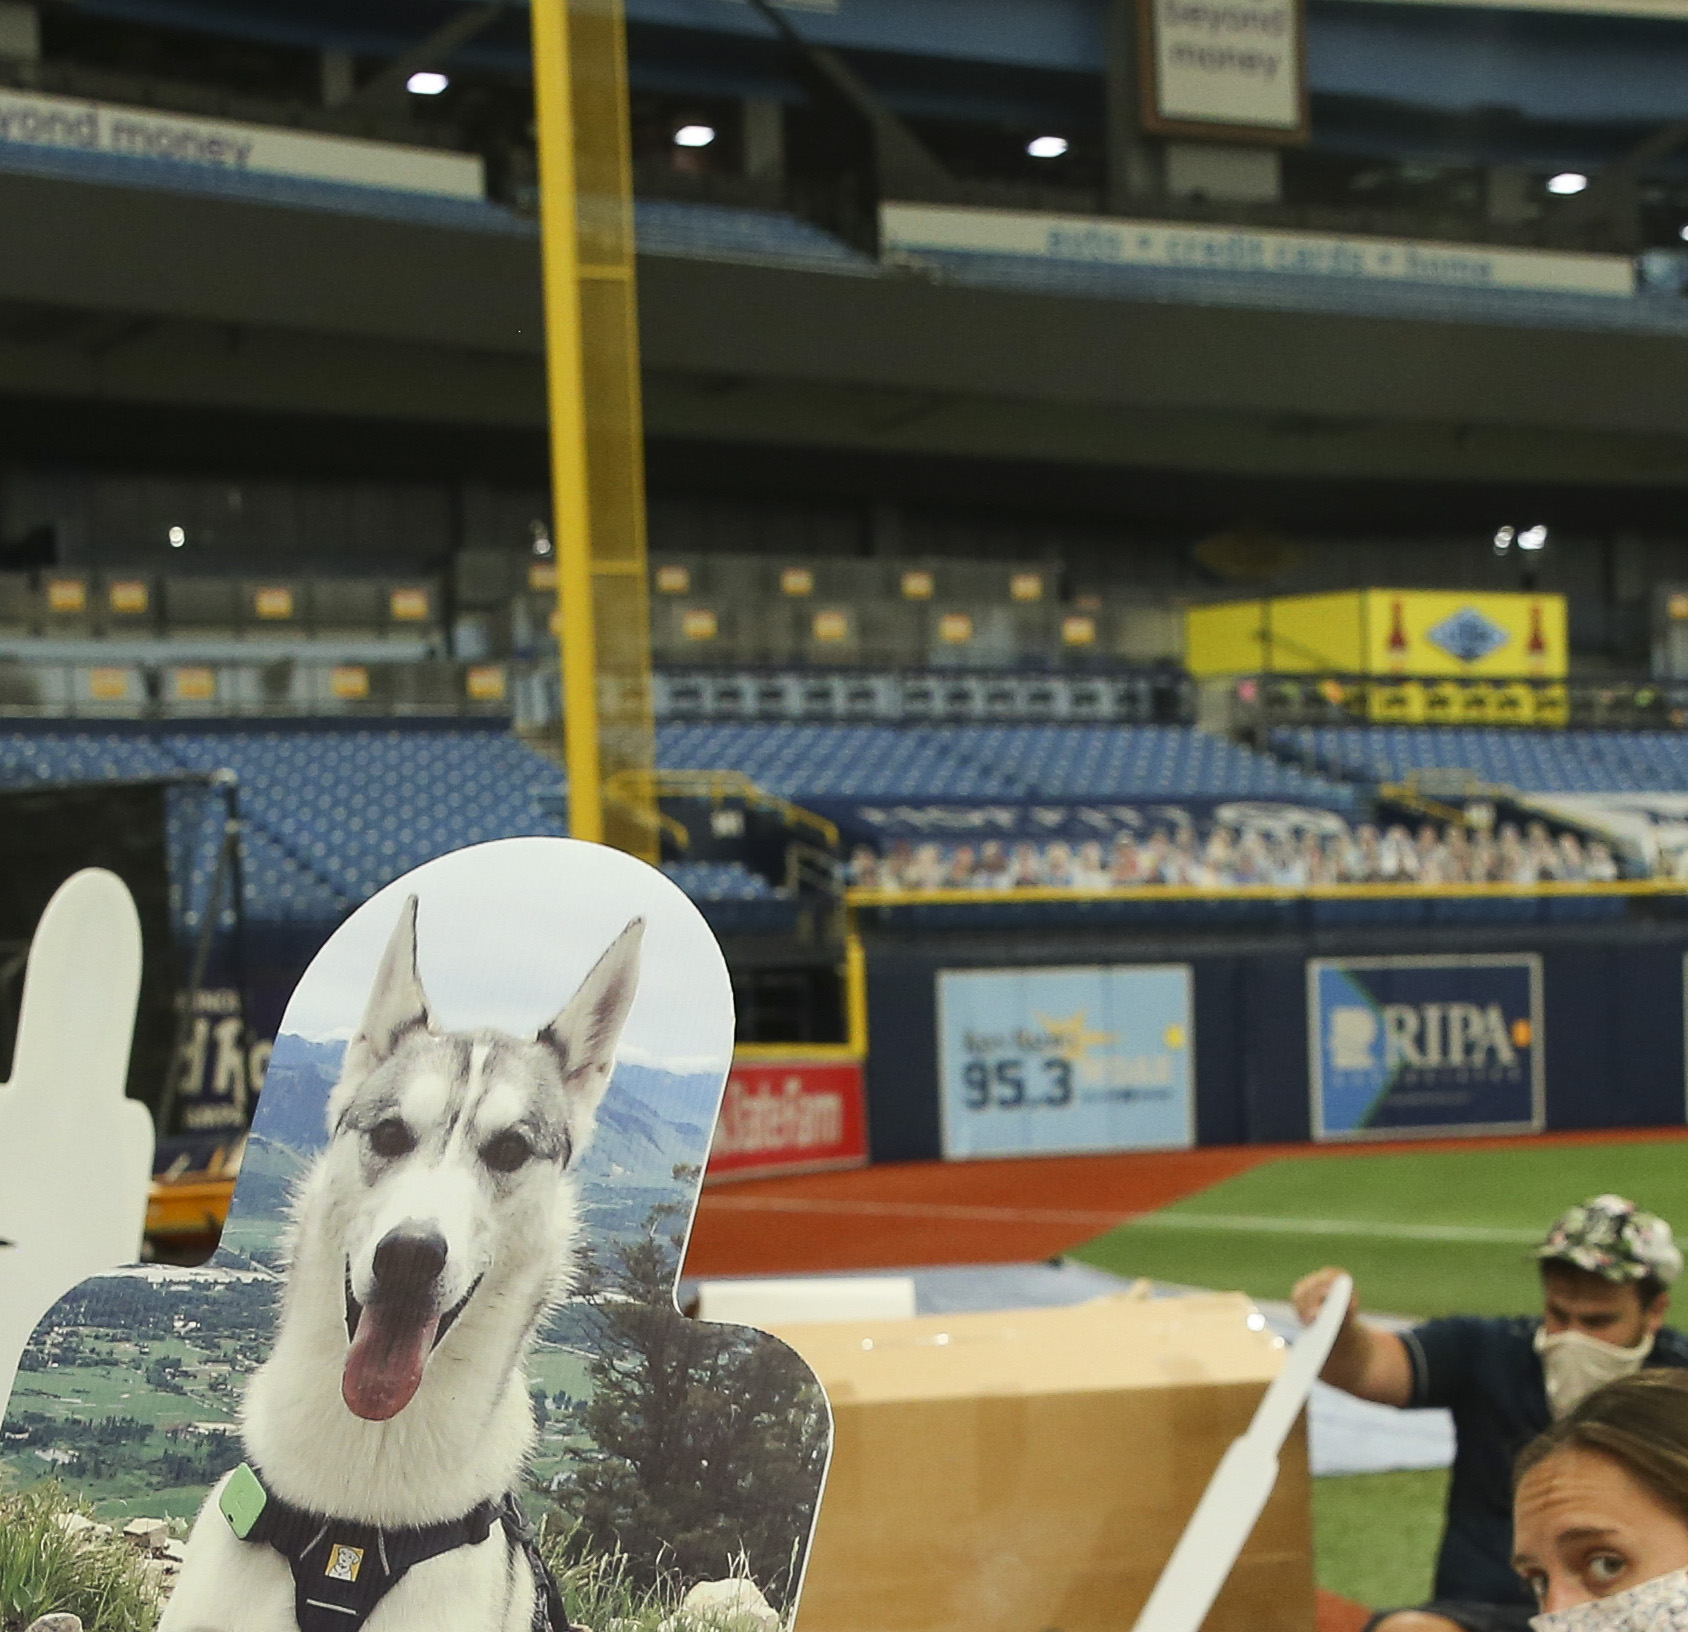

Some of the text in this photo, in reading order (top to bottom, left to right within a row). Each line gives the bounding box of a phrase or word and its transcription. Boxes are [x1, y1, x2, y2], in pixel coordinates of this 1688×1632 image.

[1169, 42, 1280, 82] money
[113, 120, 252, 168] money
[1384, 1002, 1518, 1070] RIPA
[963, 1058, 1073, 1111] 95.3
